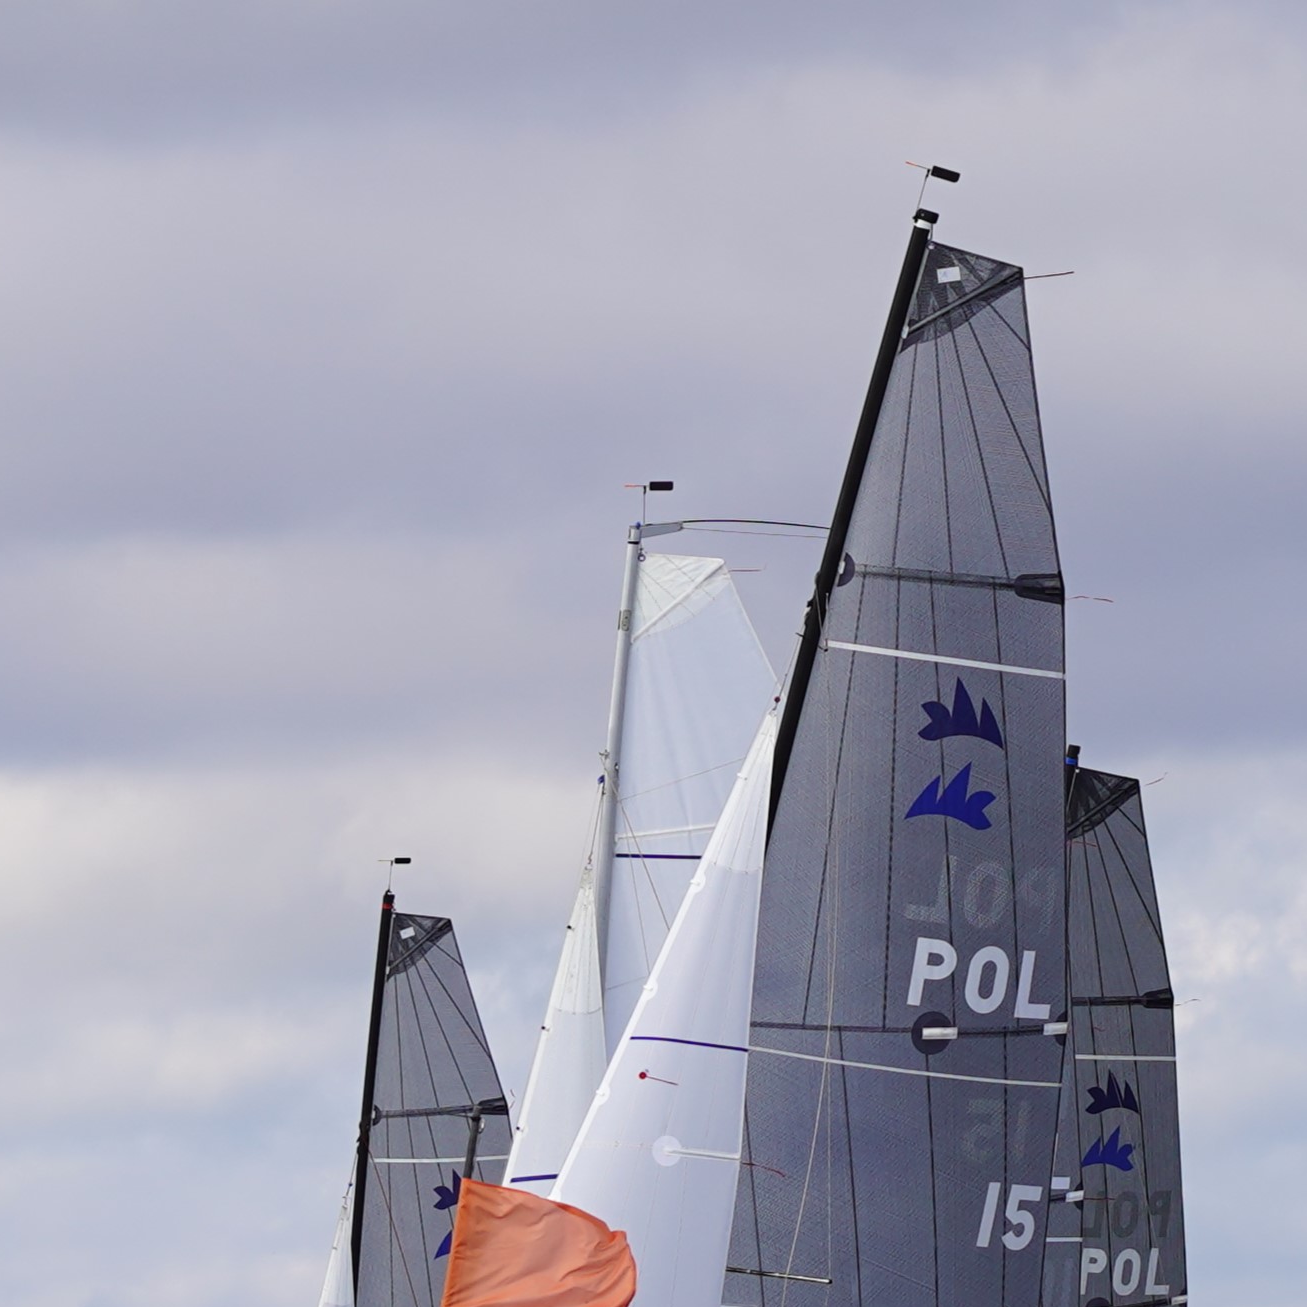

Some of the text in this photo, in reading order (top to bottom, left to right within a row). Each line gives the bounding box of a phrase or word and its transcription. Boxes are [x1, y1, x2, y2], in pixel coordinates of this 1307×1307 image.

[906, 936, 1052, 1020] POL
[976, 1181, 1043, 1251] 15
[1080, 1247, 1170, 1296] POL
